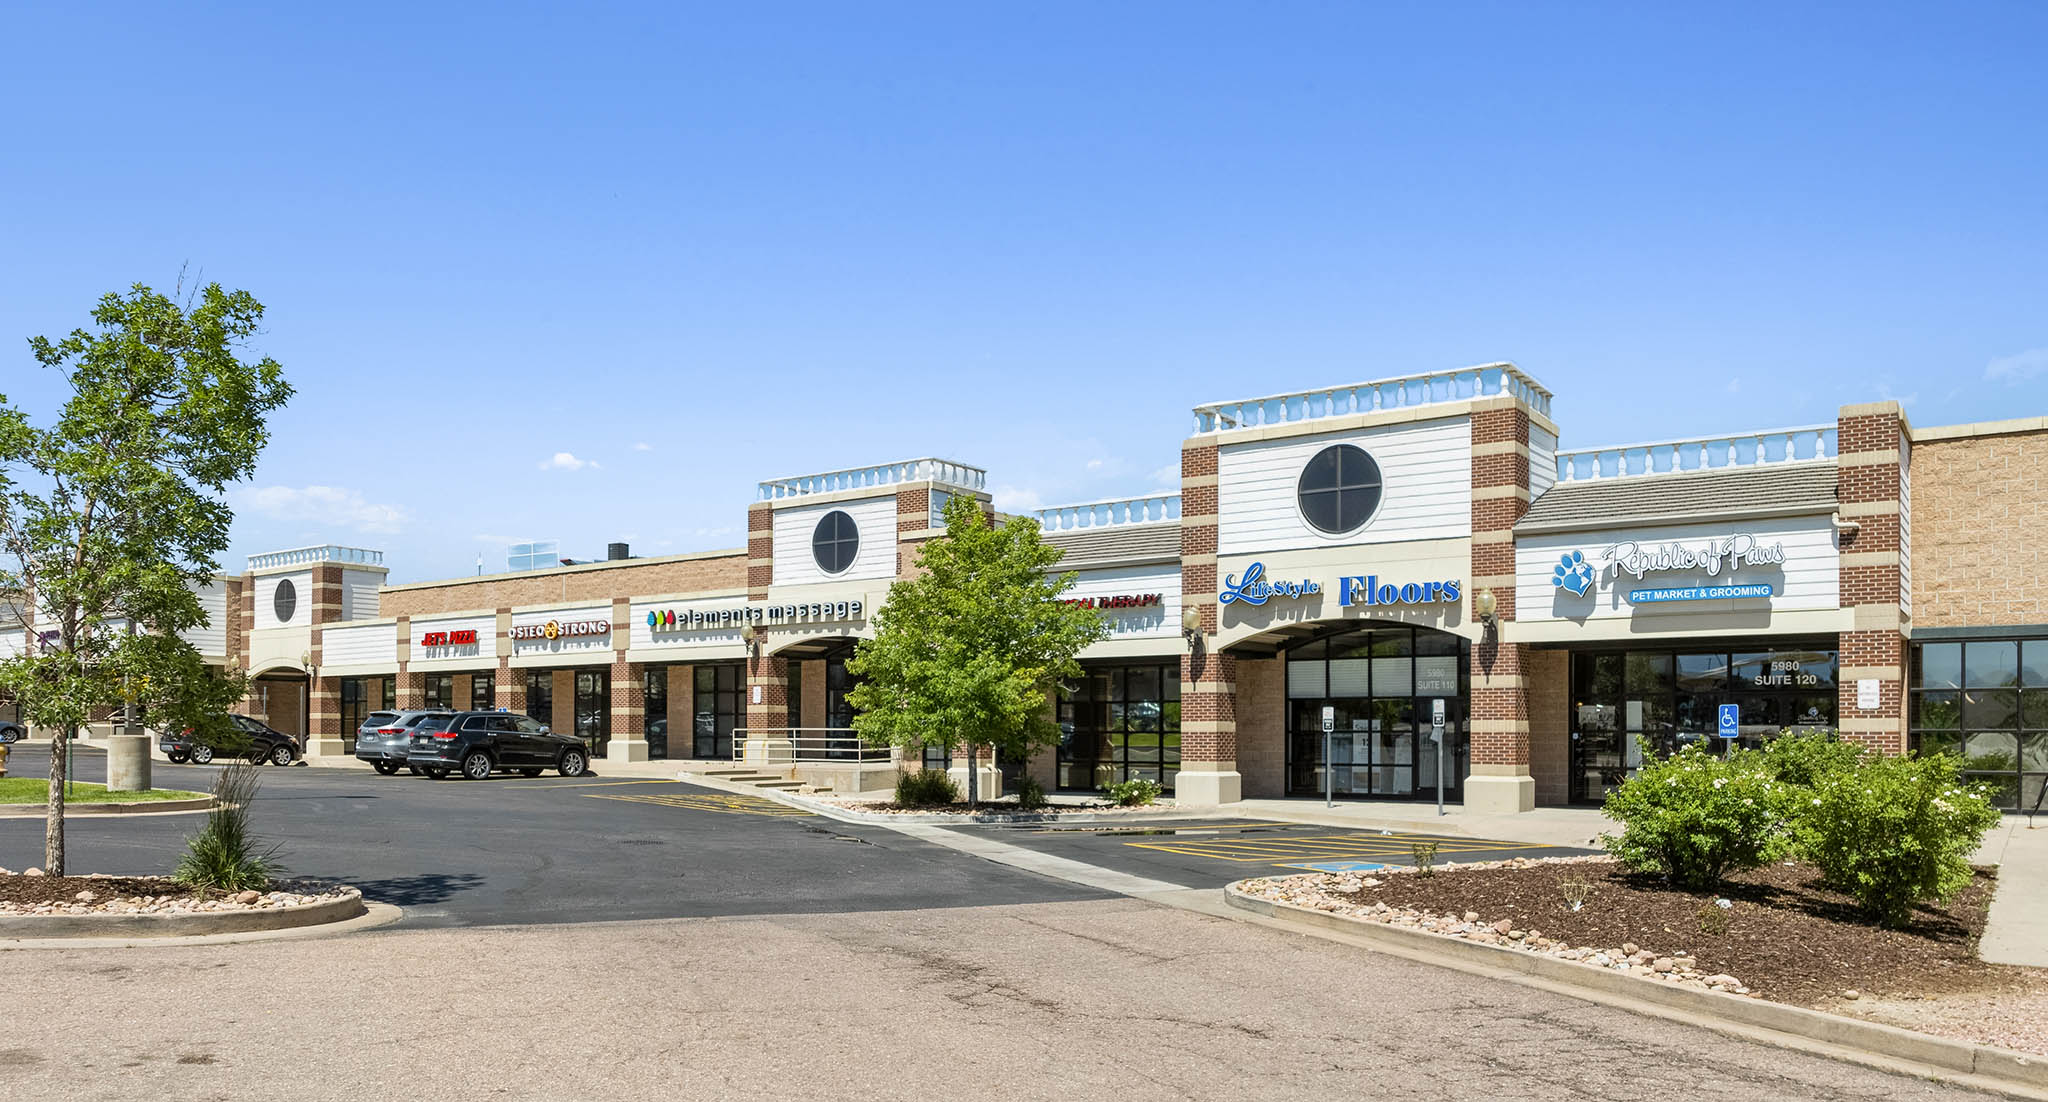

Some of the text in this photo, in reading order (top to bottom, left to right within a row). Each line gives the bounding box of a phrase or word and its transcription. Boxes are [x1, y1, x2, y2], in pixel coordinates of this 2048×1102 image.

[1601, 533, 1786, 581] Republic of Paws
[1219, 561, 1460, 607] LifeStyle Floors
[1097, 593, 1163, 609] THERAPY
[1632, 586, 1770, 601] PET MARKET & GROOMING
[677, 600, 863, 625] elements massage
[421, 629, 478, 647] JET'S PIZZA
[1770, 660, 1800, 672] 5980
[1417, 680, 1455, 690] SUITE 110
[1754, 674, 1817, 686] SUITE 120
